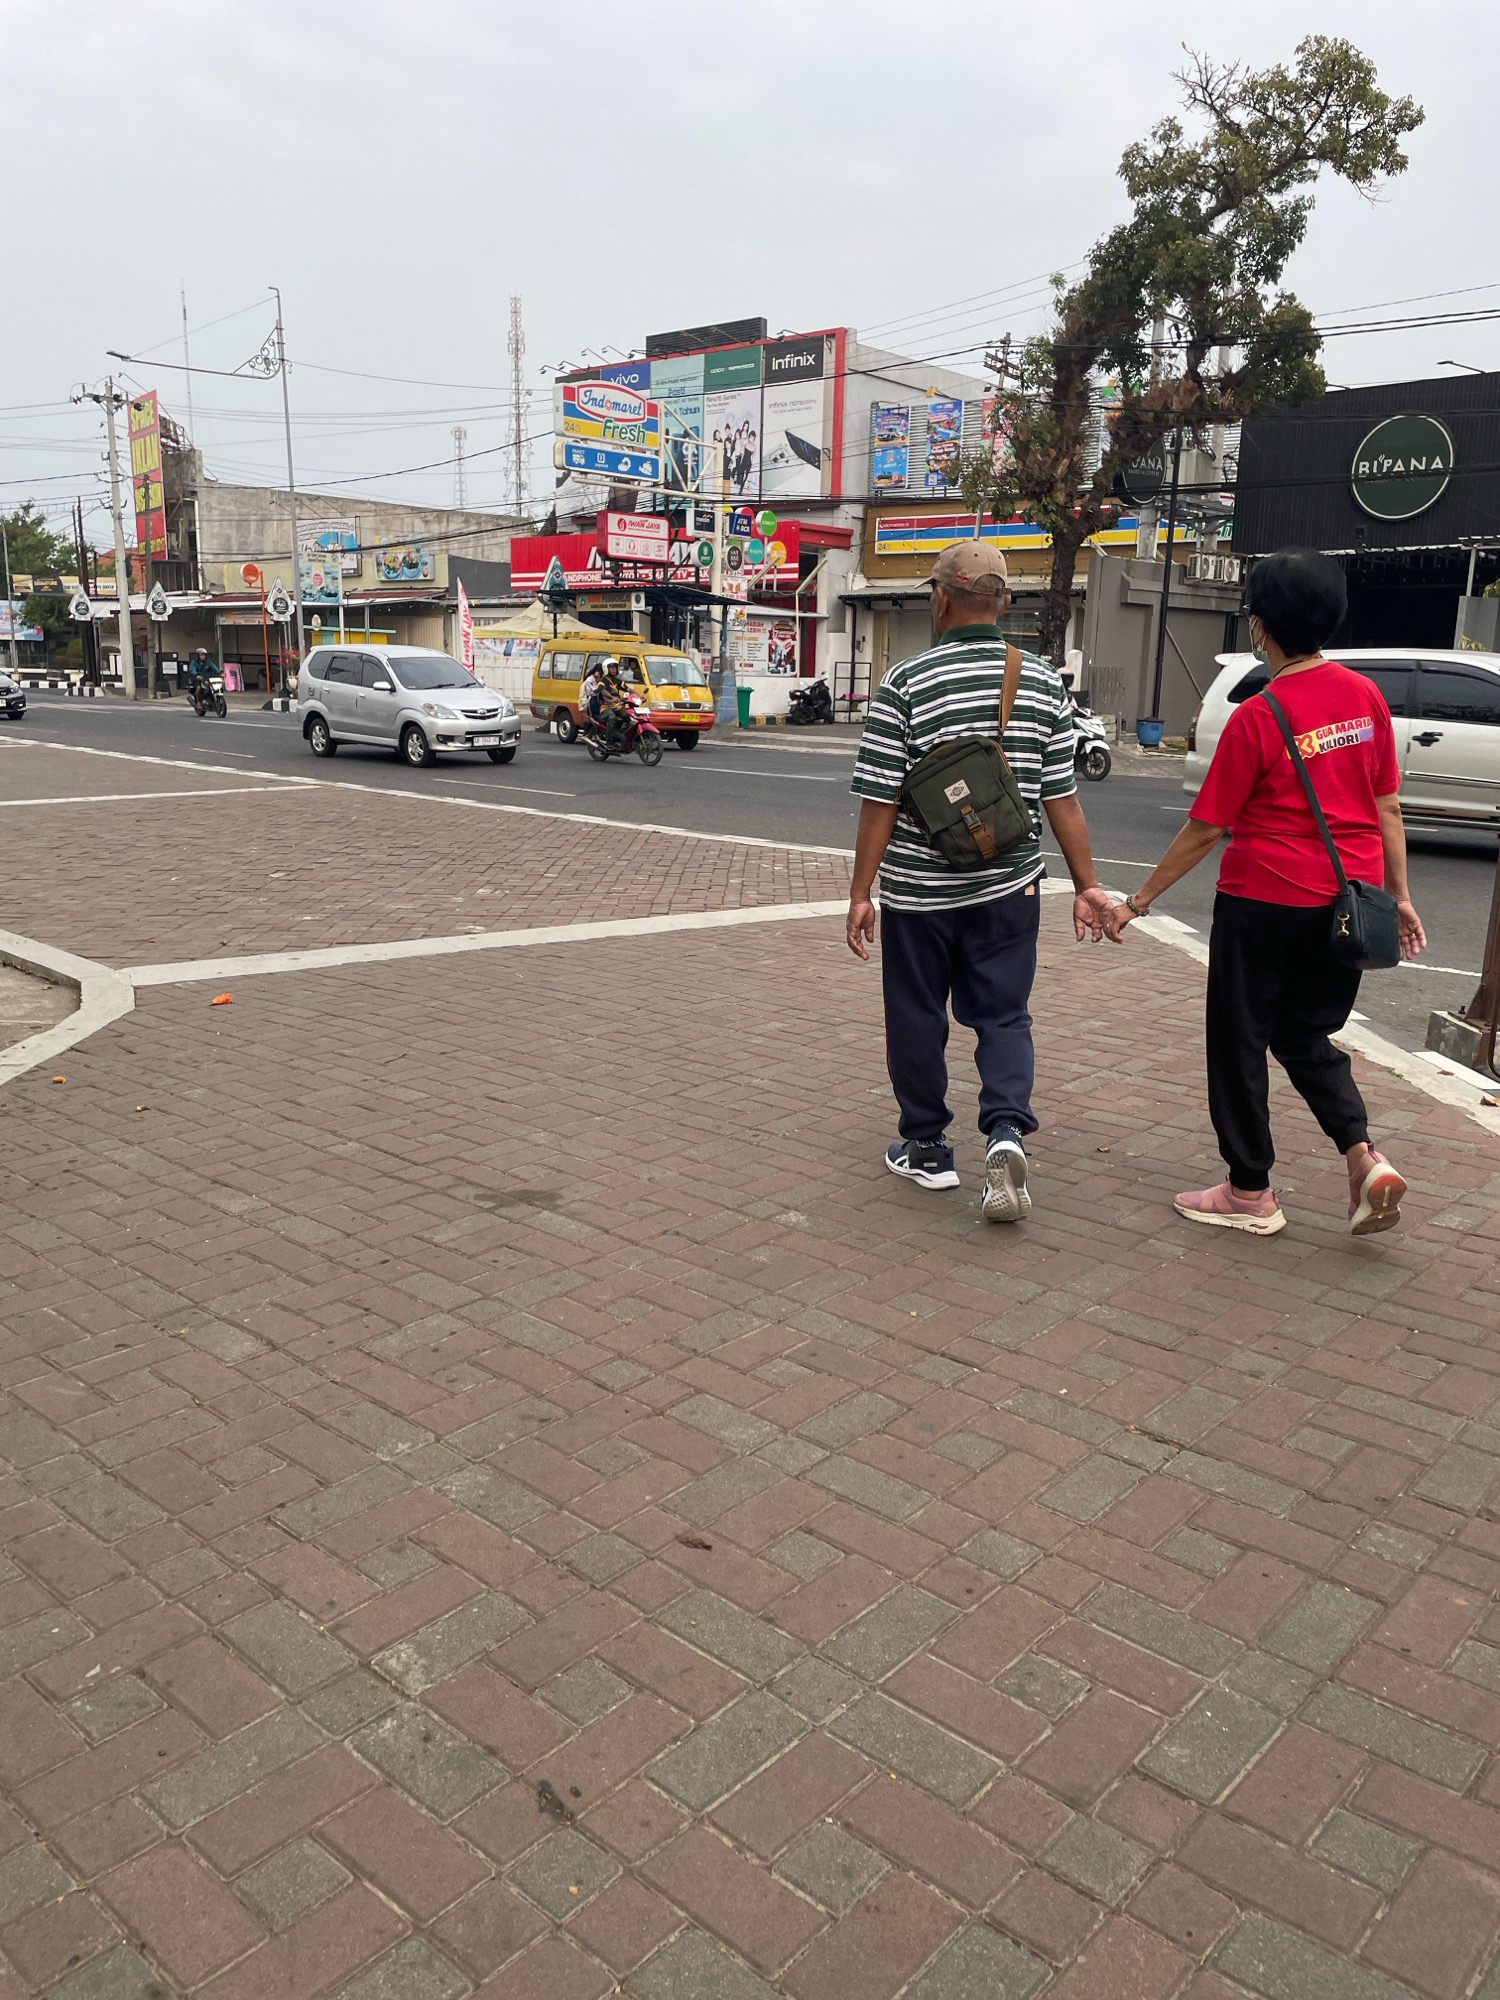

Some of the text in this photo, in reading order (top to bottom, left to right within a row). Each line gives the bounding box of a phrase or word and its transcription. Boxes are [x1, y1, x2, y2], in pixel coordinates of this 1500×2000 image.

[611, 373, 640, 386] vivo
[581, 389, 643, 416] Indomaret
[602, 418, 647, 446] Fresh
[1358, 455, 1444, 474] RIPANA
[628, 520, 661, 530] IWAN JAYA
[568, 573, 602, 583] NDPHONE
[1315, 717, 1373, 740] GUA MARIA
